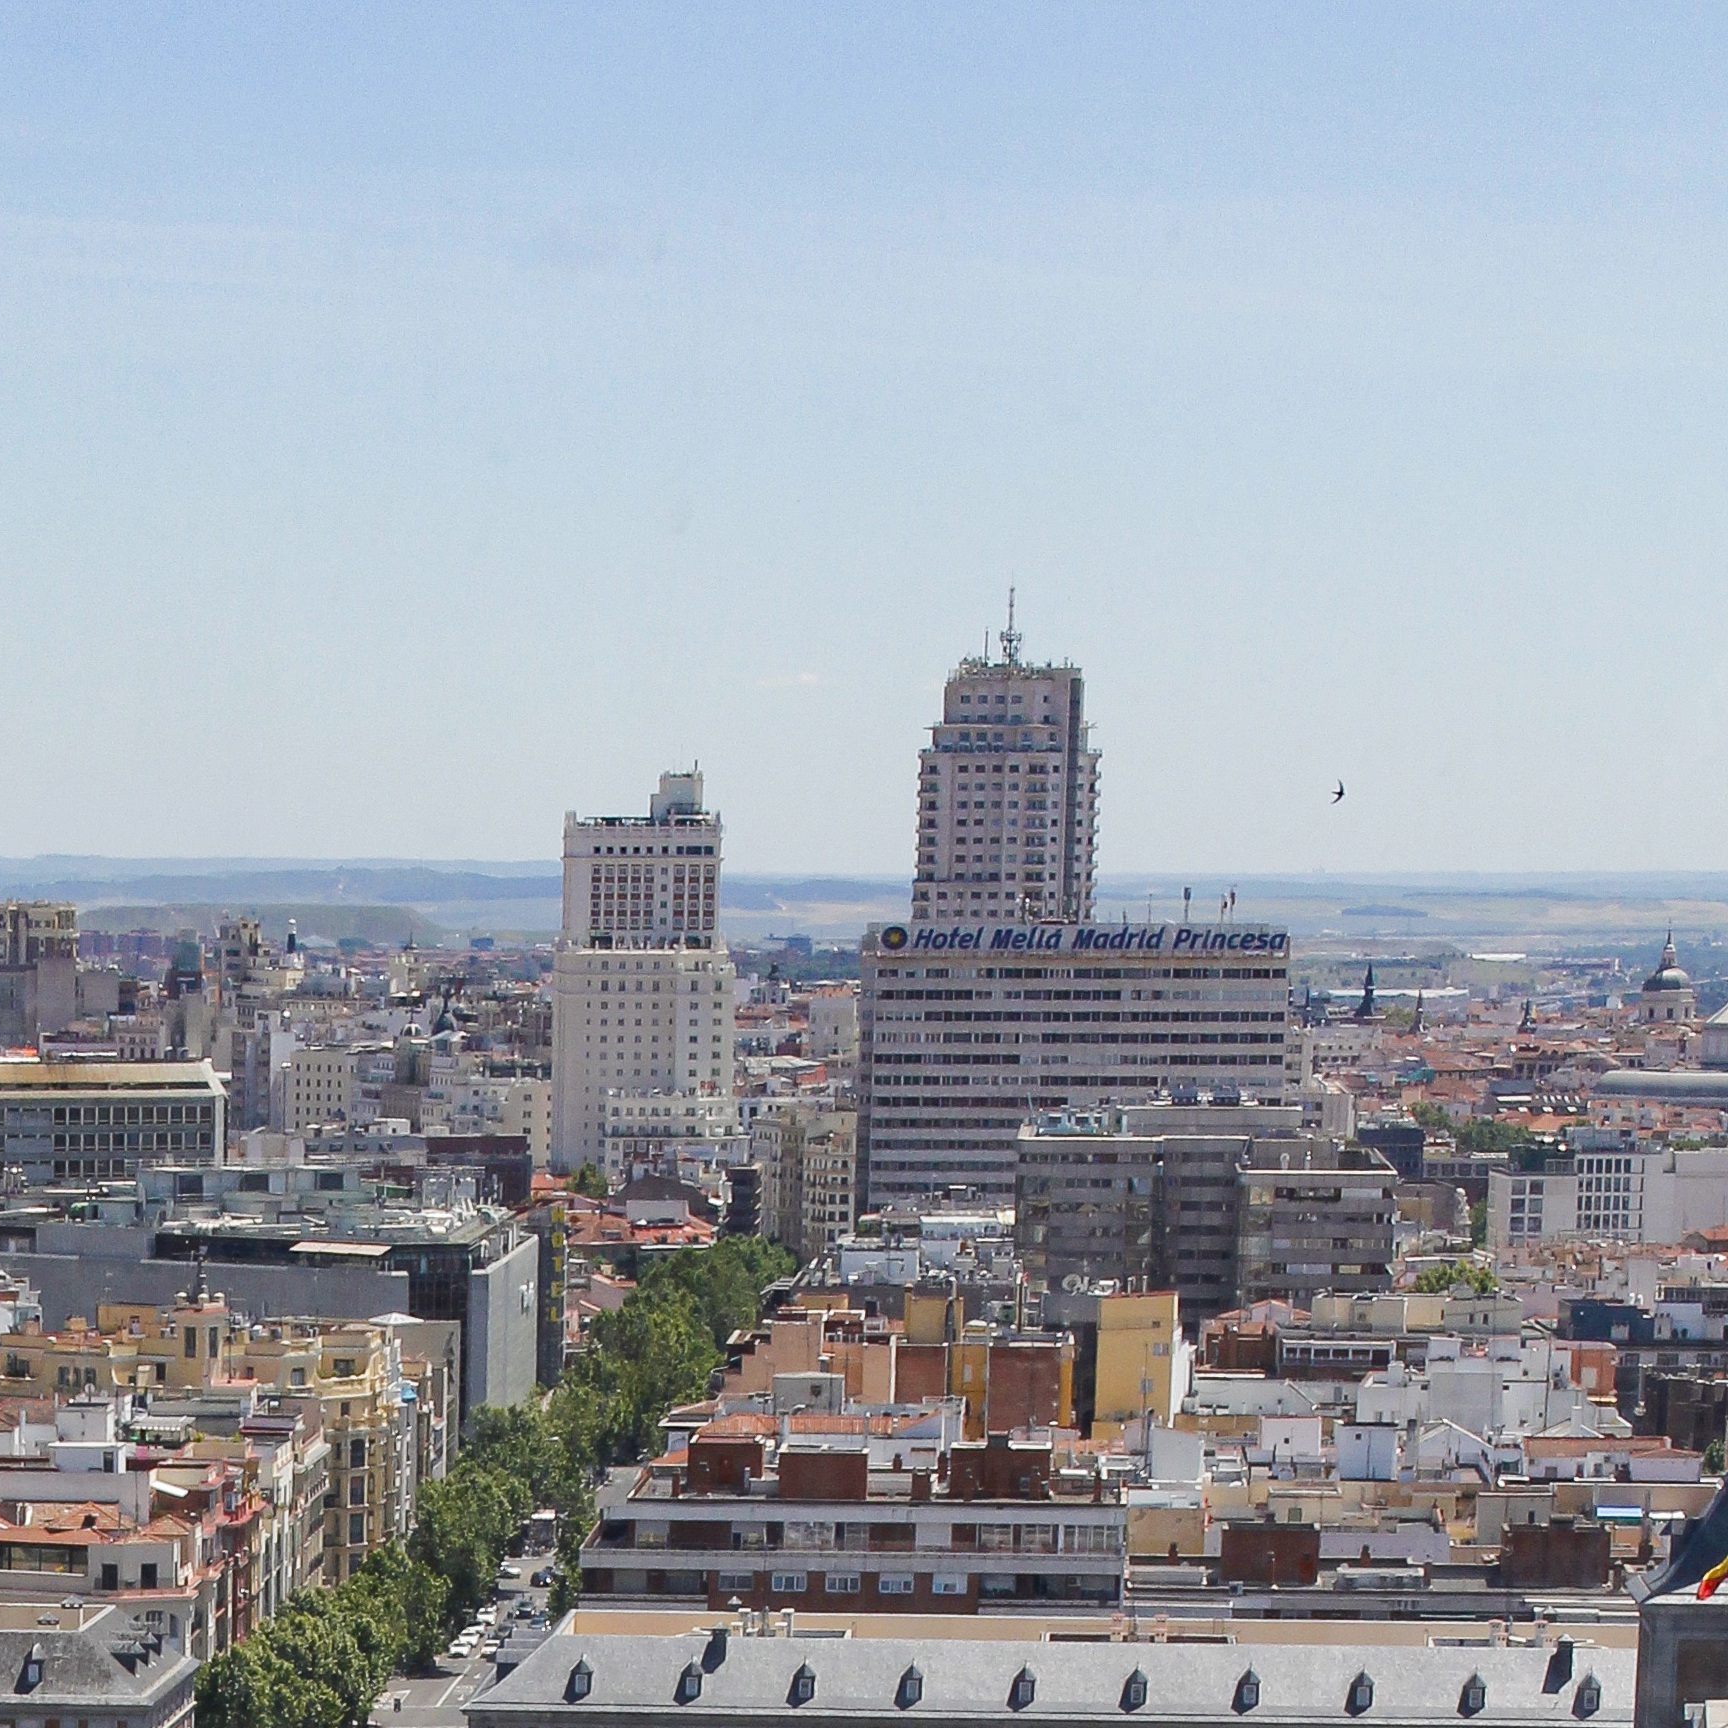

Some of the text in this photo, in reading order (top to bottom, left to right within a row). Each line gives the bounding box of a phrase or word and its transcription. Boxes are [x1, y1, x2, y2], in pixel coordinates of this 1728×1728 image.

[914, 925, 1288, 950] Hotel Meliá Madrid Princesa
[549, 1206, 565, 1323] HOTEL
